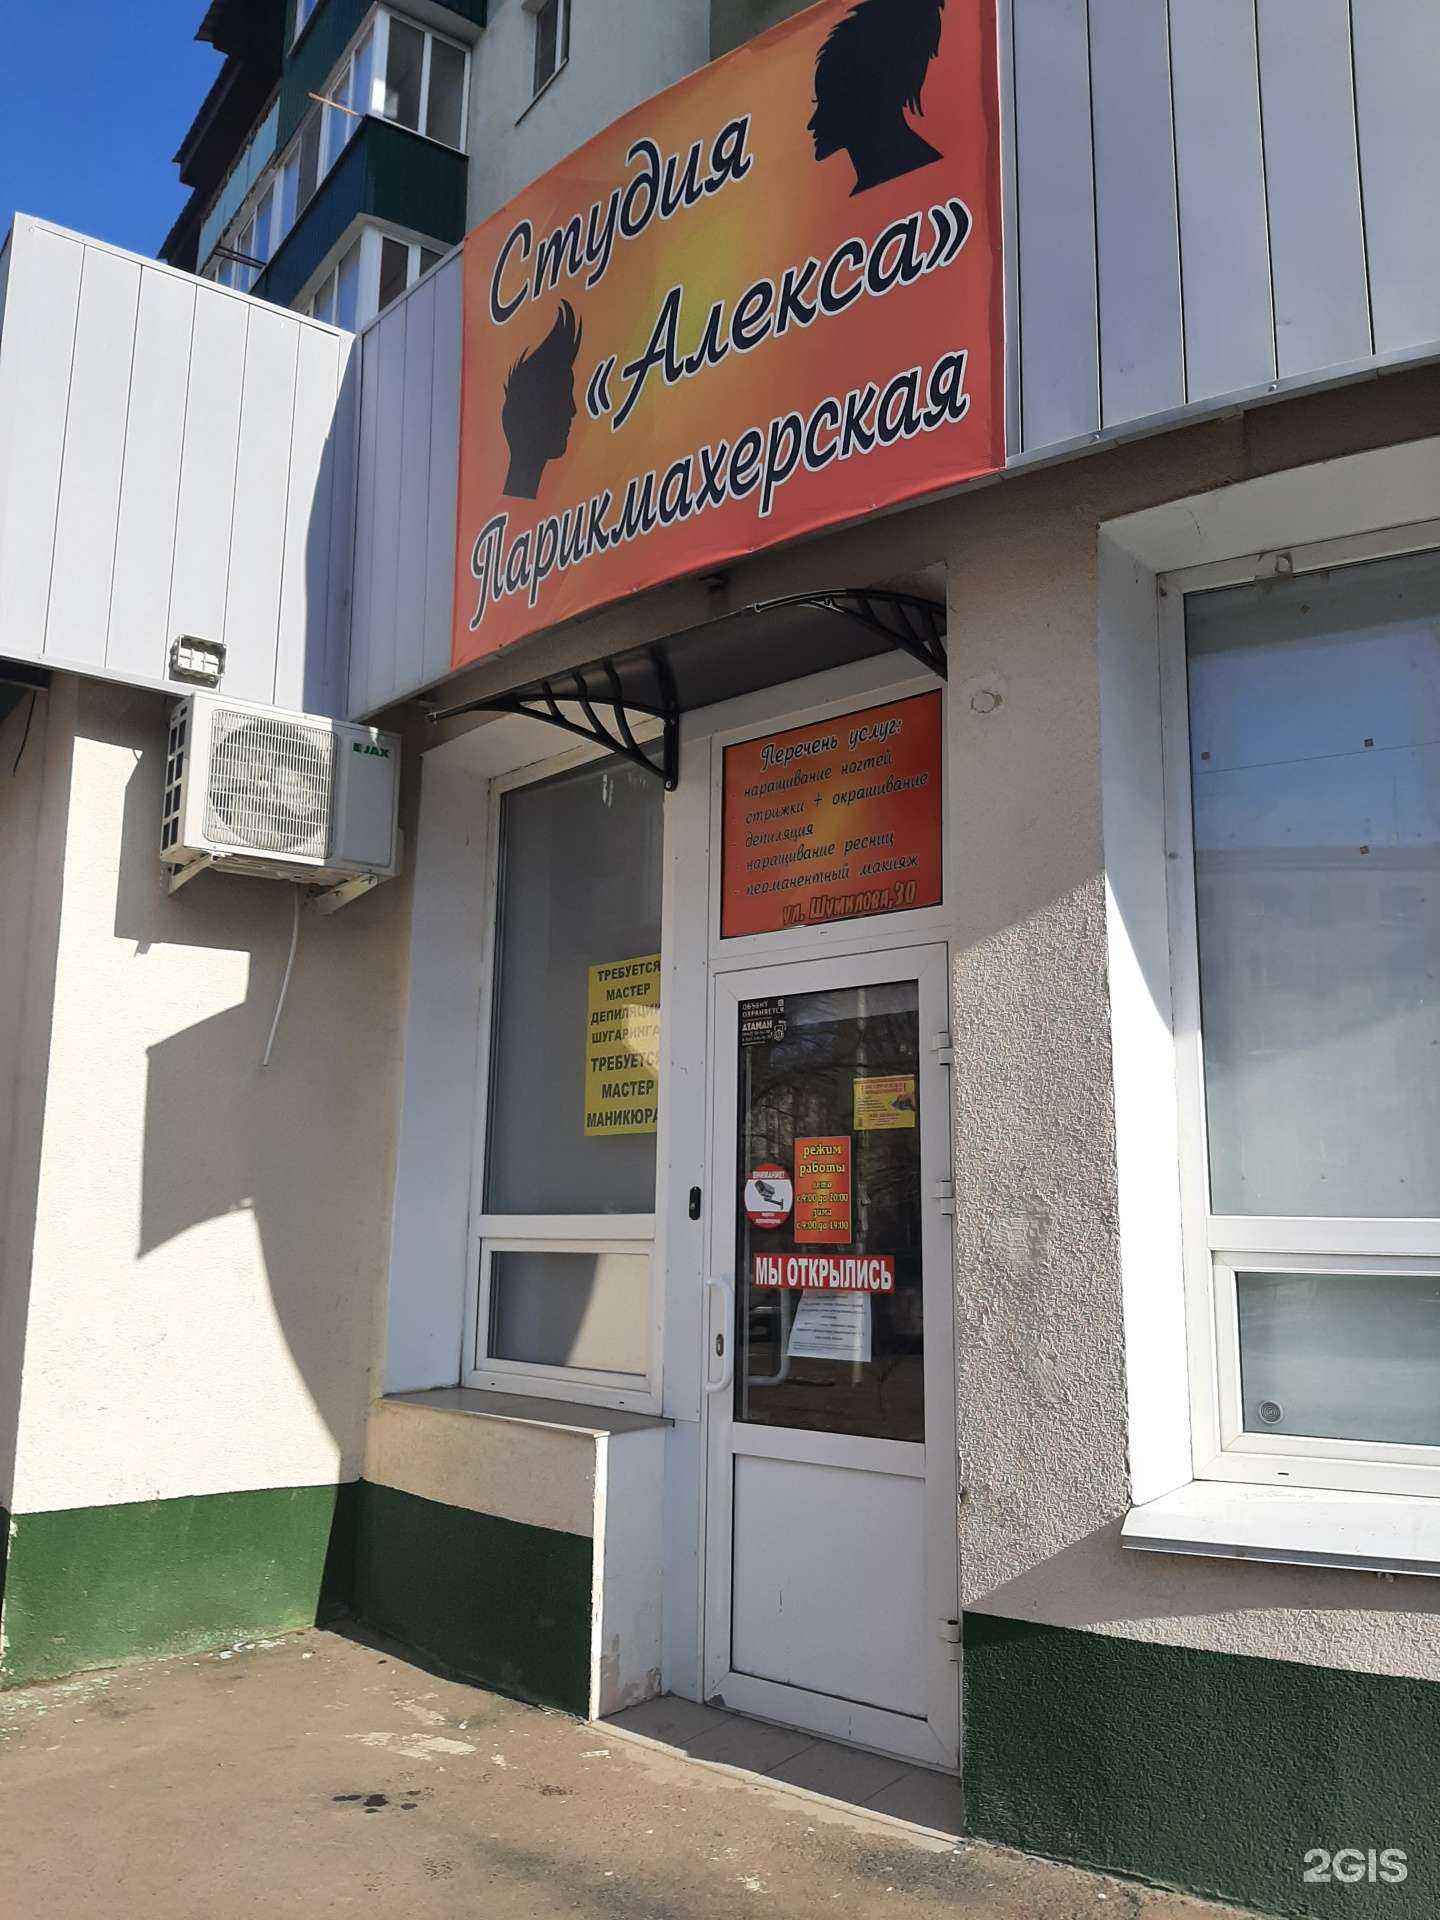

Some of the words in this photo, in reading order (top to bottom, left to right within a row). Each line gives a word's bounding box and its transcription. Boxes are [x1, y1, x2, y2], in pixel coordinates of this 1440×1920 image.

[490, 113, 752, 325] Студия
[586, 198, 971, 431] «Алекса»
[469, 349, 970, 631] Парикмахерская
[761, 737, 838, 773] Перечень
[849, 718, 903, 749] услуг:
[744, 766, 832, 798] наращивание
[841, 749, 893, 776] ногтей
[745, 802, 805, 825] стрижки
[832, 771, 928, 806] окрашивание
[745, 823, 814, 848] депиляция
[746, 842, 836, 872] наращивание
[844, 831, 894, 856] ресниц
[746, 865, 850, 896] перманентный
[859, 854, 919, 876] макияж
[597, 960, 661, 982] ТРЕБУЕТСЯ
[606, 982, 651, 1001] МАСТЕР
[601, 1079, 654, 1099] МАСТЕР
[800, 1161, 845, 1177] работы
[803, 1144, 843, 1159] режим
[755, 1256, 782, 1285] МЫ
[787, 1257, 892, 1290] ОТКРЫЛИСЬ
